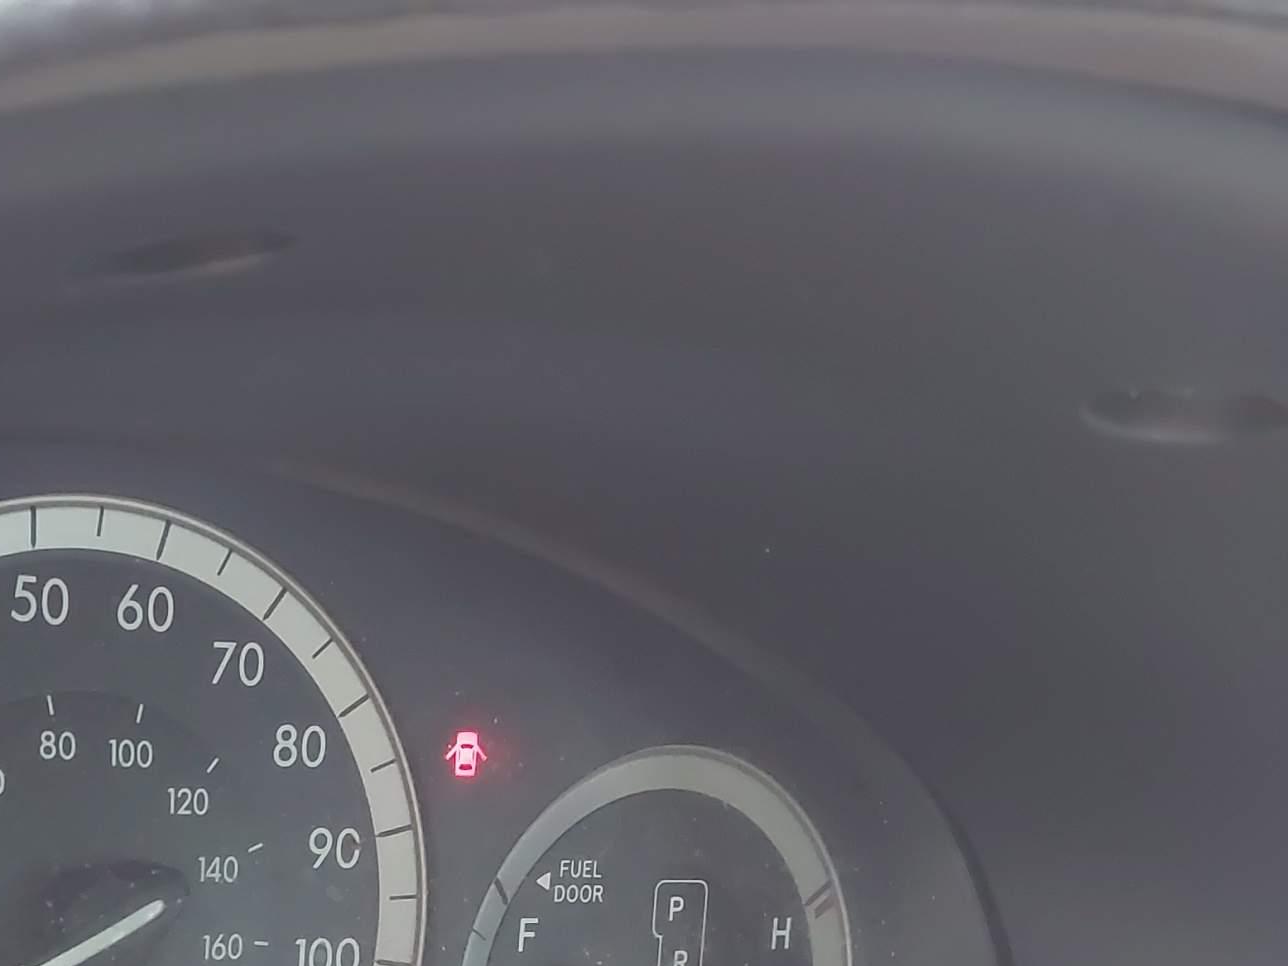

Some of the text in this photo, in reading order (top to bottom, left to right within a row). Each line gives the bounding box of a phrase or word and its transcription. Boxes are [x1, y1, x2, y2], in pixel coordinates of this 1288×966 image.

[11, 575, 69, 625] 50
[116, 584, 175, 632] 60
[211, 641, 265, 686] 70
[39, 730, 77, 761] 80
[109, 739, 153, 770] 100
[273, 724, 327, 768] 80
[168, 787, 209, 816] 120
[308, 828, 361, 870] 90
[198, 856, 239, 883] 140
[560, 860, 602, 879] FUEL
[554, 884, 604, 903] DOOR
[669, 897, 684, 921] P
[202, 935, 243, 961] 160
[518, 918, 538, 952] F
[771, 918, 791, 950] H
